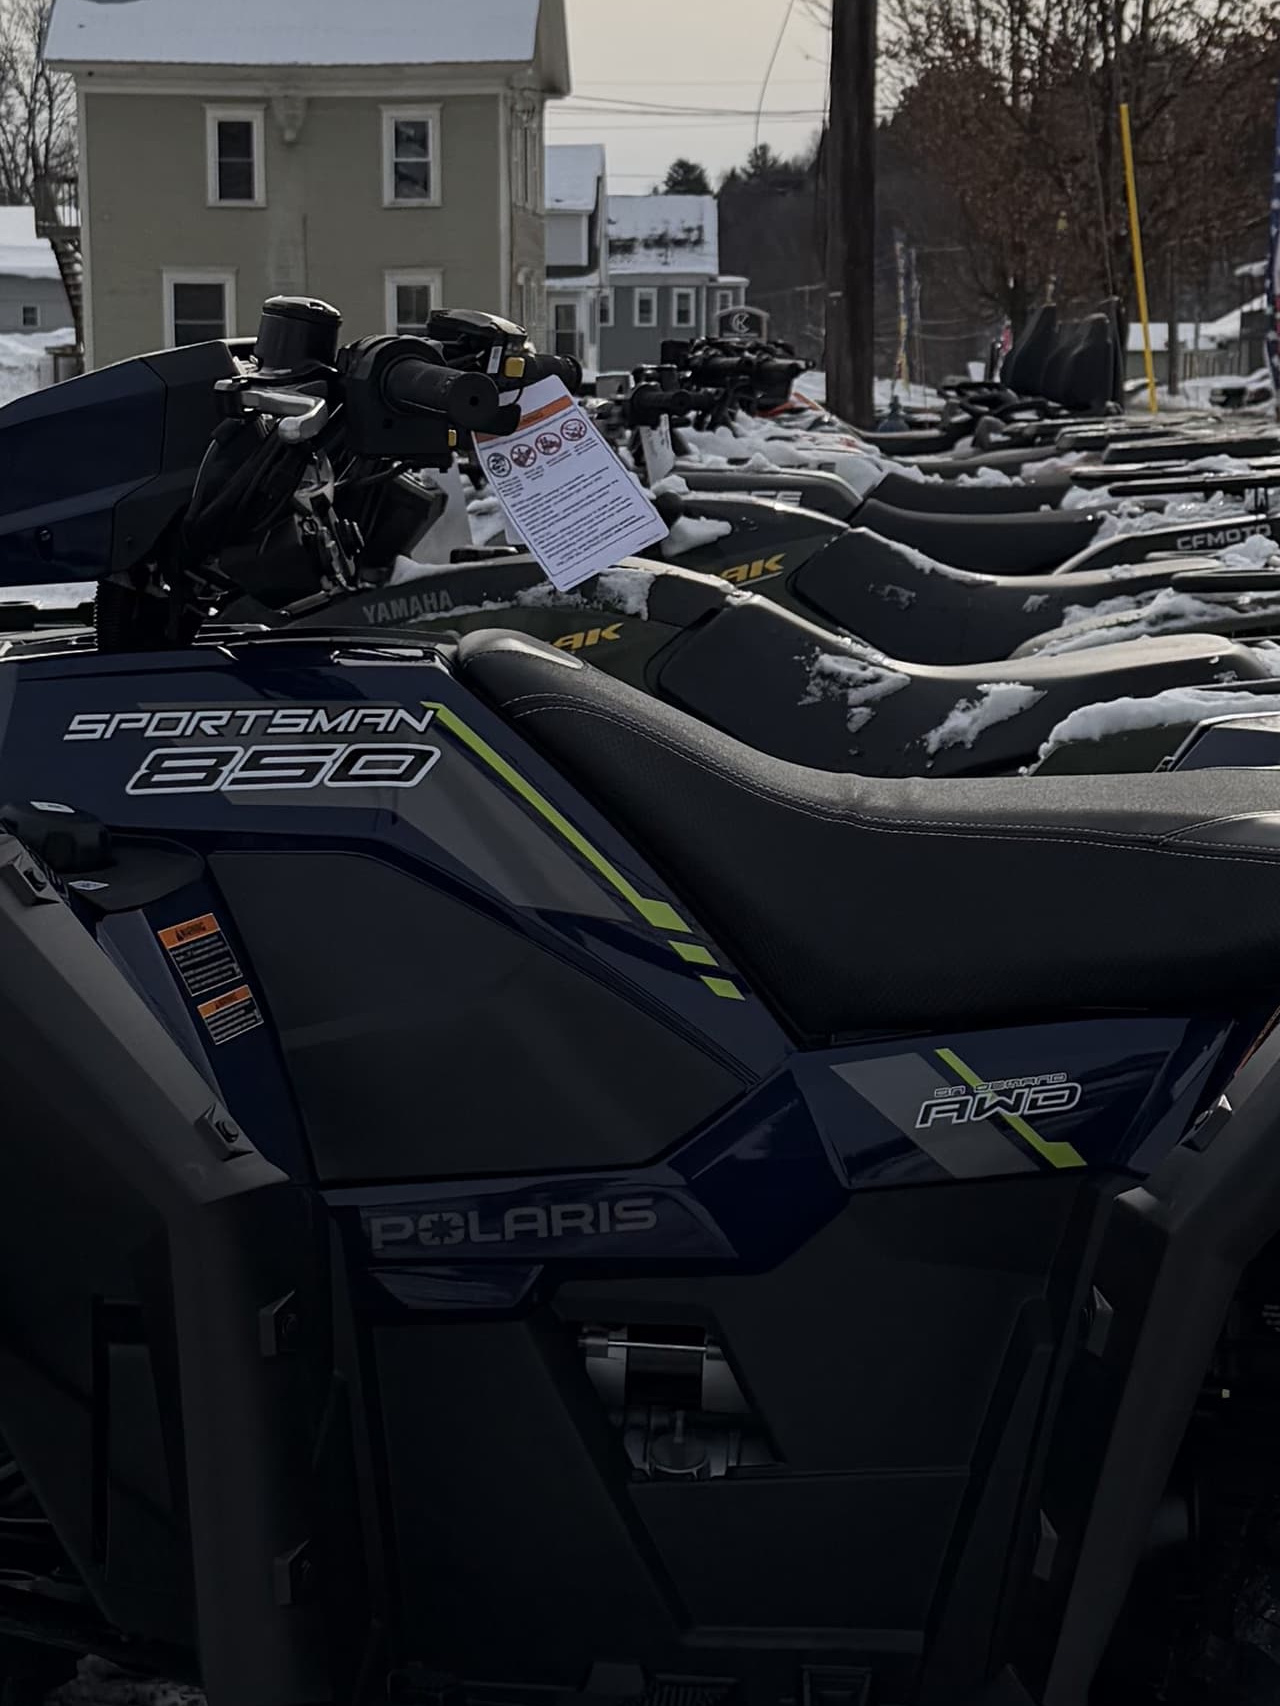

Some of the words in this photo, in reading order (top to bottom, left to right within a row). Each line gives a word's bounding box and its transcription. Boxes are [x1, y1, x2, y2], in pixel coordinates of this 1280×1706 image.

[1176, 523, 1272, 550] CFMOTO
[362, 589, 455, 624] YAMAHA
[63, 708, 435, 741] SPORTSMAN
[125, 744, 441, 795] 850
[915, 1082, 1082, 1128] AWD
[371, 1198, 658, 1249] POLARIS
